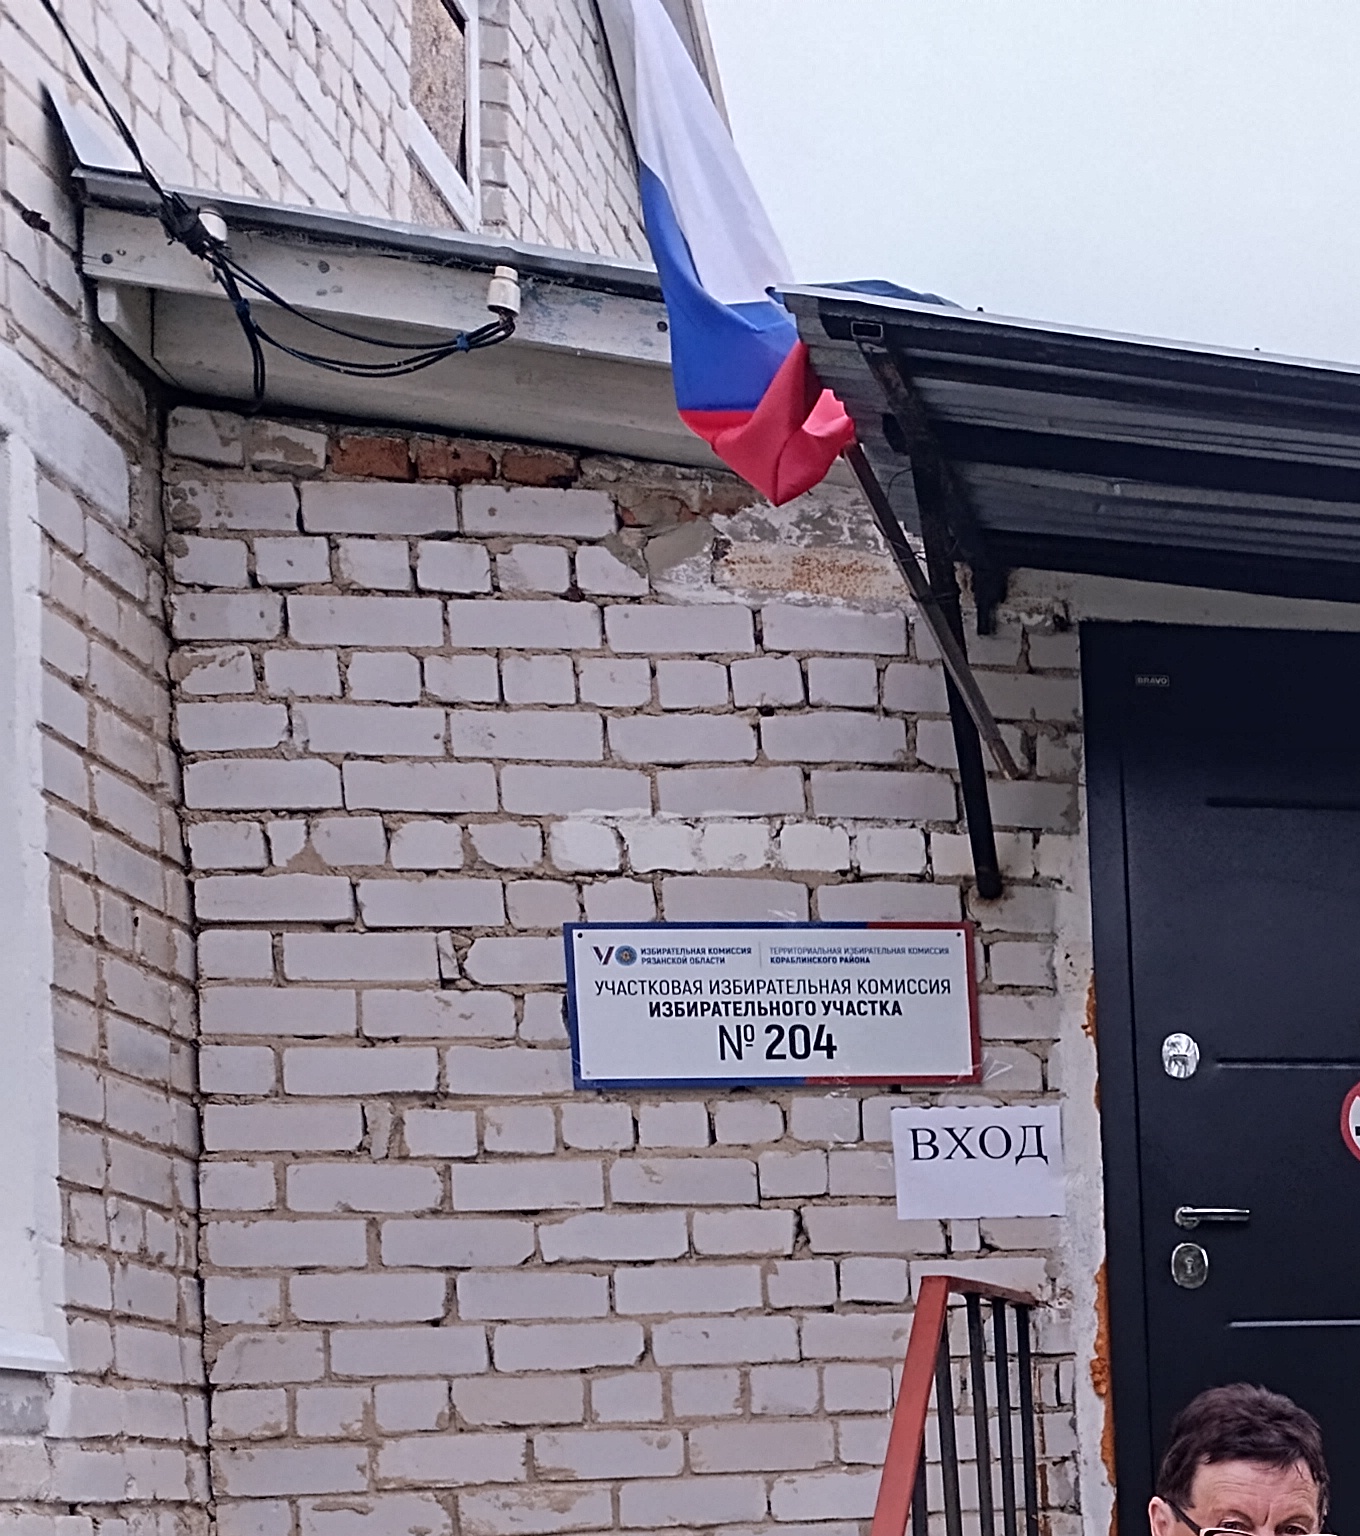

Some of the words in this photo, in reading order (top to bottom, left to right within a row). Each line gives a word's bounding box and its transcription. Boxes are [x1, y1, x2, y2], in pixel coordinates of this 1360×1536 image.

[640, 947, 706, 956] ИЗБИРАТЕЛЬНАЯ
[708, 947, 752, 955] КОМИССИЯ
[769, 947, 842, 955] ТЕРРИТОРИАЛЬНАЯ
[843, 947, 906, 955] ИЗБИРАТЕЛЬНАЯ
[907, 947, 950, 955] КОМИССИЯ
[641, 956, 687, 965] РЯЗАНСКОЙ
[690, 957, 726, 965] ОБЛАСТИ
[770, 956, 837, 964] КОРАБЛИНСКОГО
[839, 955, 871, 964] РАЙОНА
[594, 979, 703, 996] УЧАСТКОВАЯ
[709, 978, 851, 996] ИЗБИРАТЕЛЬНАЯ
[857, 978, 951, 995] КОМИССИЯ
[649, 1000, 817, 1018] ИЗБИРАТЕЛЬНОГО
[822, 1000, 903, 1017] УЧАСТКА
[719, 1024, 755, 1061] №
[764, 1023, 838, 1060] 204
[908, 1124, 1049, 1166] ВХОД
